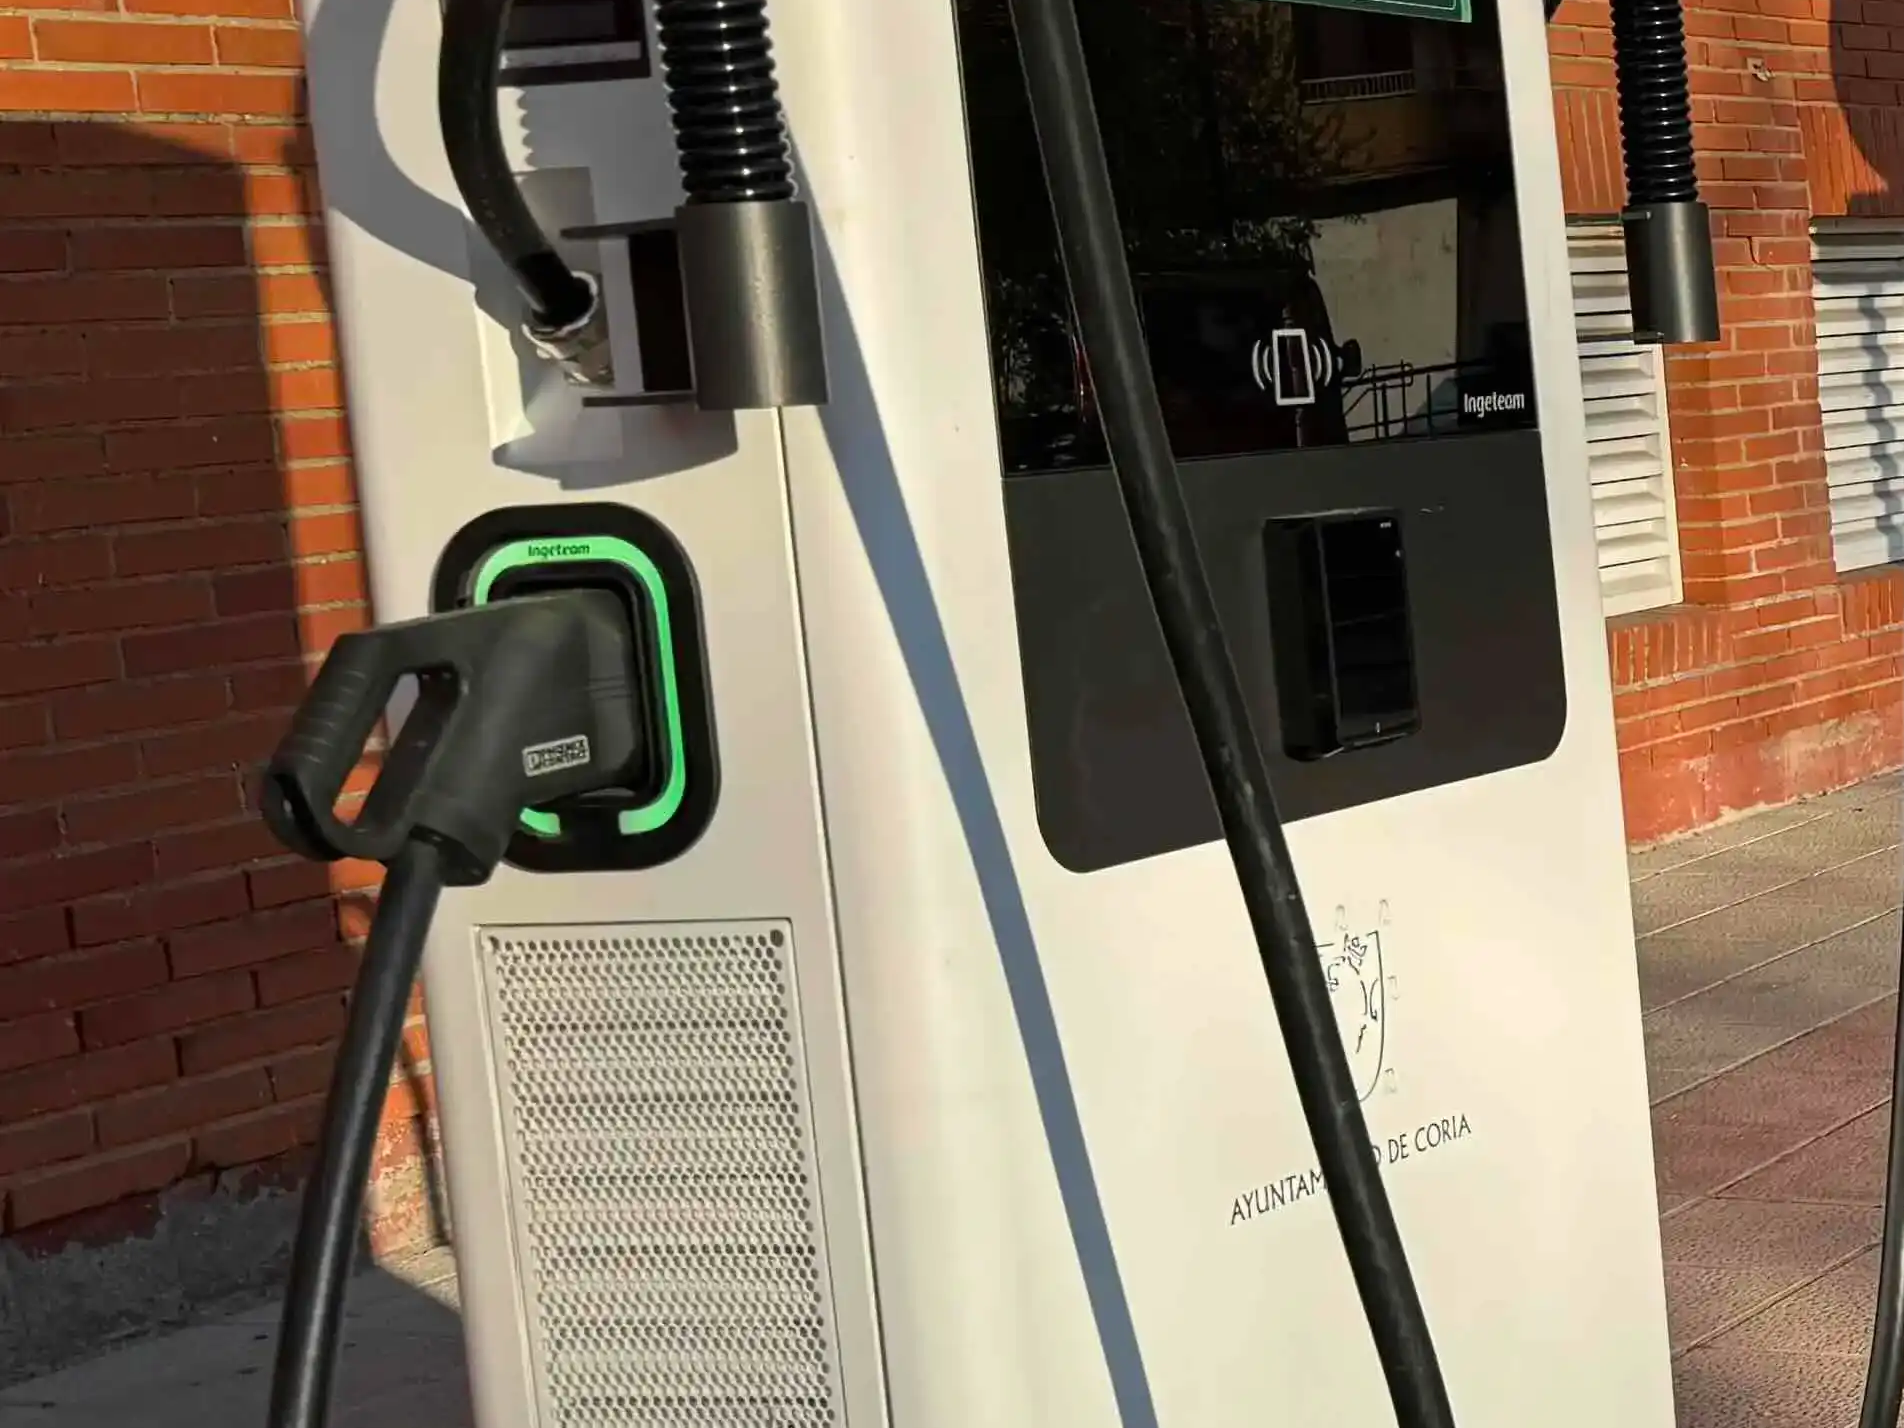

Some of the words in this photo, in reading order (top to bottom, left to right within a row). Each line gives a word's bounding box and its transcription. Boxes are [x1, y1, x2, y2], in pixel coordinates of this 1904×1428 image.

[1463, 391, 1525, 418] Ingeteam
[528, 544, 590, 560] Ingeteam
[1231, 1145, 1382, 1225] AYUNTAMO
[1388, 1134, 1409, 1163] DE
[1414, 1114, 1471, 1153] CORIA
